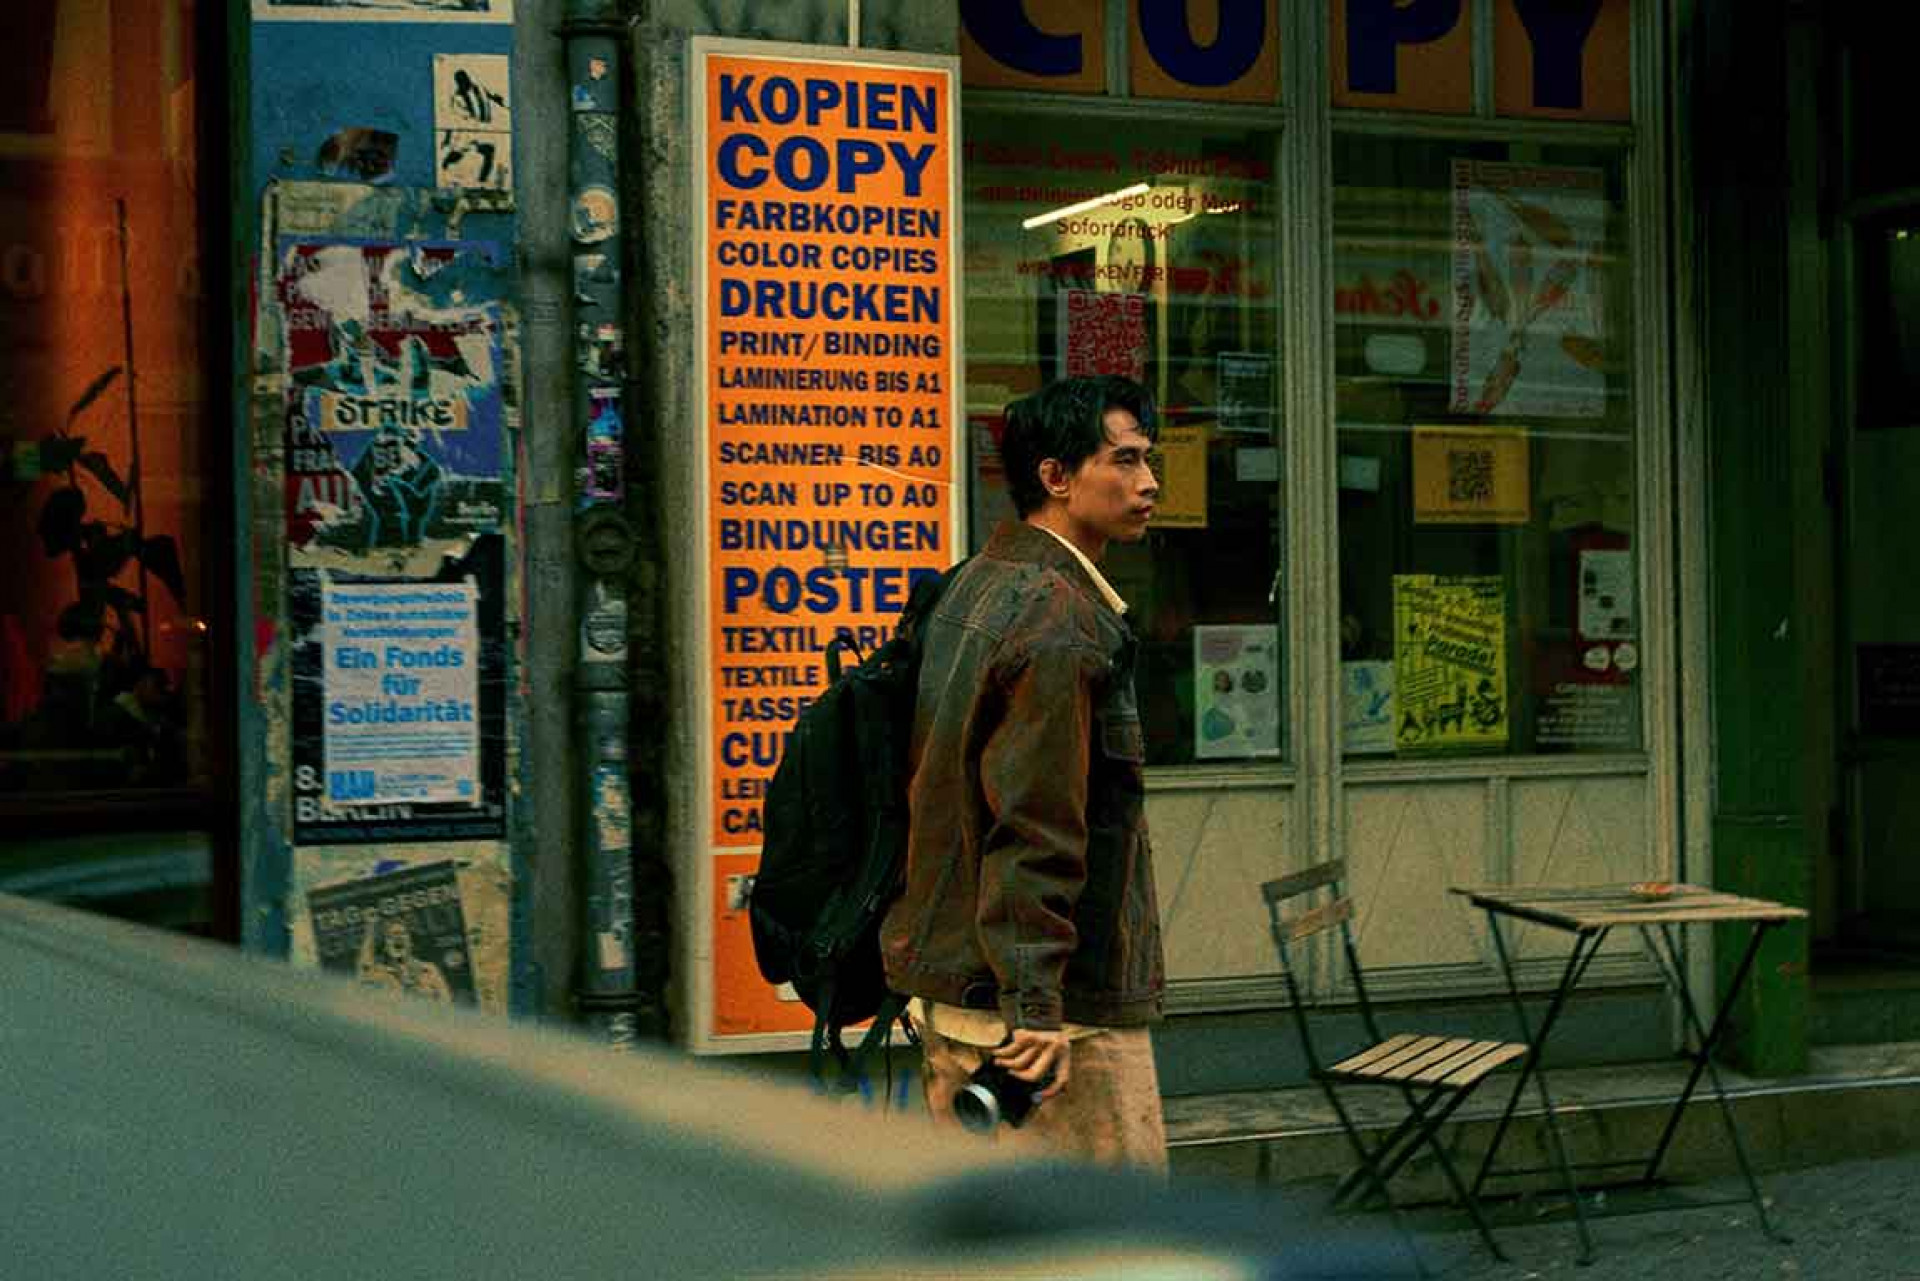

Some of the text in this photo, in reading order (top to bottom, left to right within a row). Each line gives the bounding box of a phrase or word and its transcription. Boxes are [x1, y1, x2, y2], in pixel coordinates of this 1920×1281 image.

[960, 0, 1598, 109] COPY
[720, 74, 937, 133] KOPIEN
[717, 133, 936, 197] COPY
[717, 200, 940, 238] FARBKOPIEN
[718, 241, 937, 273] COLOR COPIES
[720, 278, 940, 324] DRUCKEN
[720, 331, 941, 361] PRINT/ BINDING
[719, 367, 941, 394] LAMINIERUNG BIS A1
[336, 400, 455, 426] STRIKE
[718, 404, 941, 429] LAMINATION TO A1
[720, 442, 843, 466] SCANNEN
[858, 445, 900, 467] BIS
[720, 481, 797, 506] SCAN
[813, 483, 850, 507] UP
[859, 483, 893, 507] TO
[720, 520, 939, 550] BINDUNGEN
[724, 567, 942, 613] POSTE
[721, 626, 823, 653] TEXTIL
[336, 645, 464, 669] Ein Fonds
[381, 673, 423, 696] für
[721, 665, 819, 688] TEXTILE
[329, 699, 473, 724] Solidarität
[722, 808, 763, 834] CA
